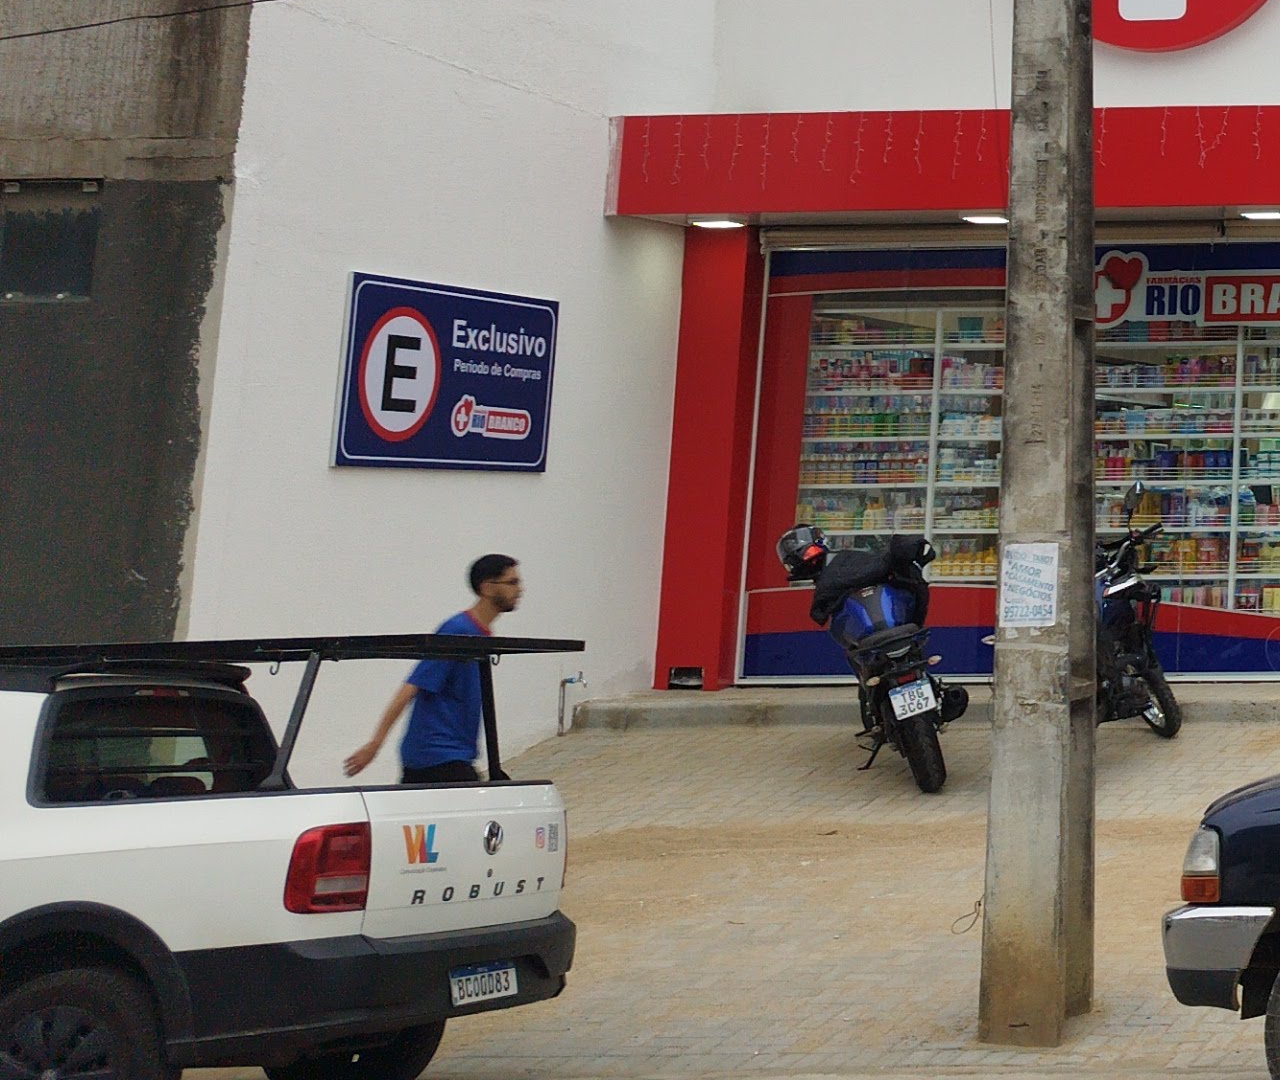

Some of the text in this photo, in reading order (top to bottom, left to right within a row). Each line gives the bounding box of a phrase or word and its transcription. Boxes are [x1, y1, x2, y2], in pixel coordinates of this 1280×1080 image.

[1144, 283, 1202, 316] RIO
[452, 318, 547, 358] Exclusivo
[381, 333, 422, 414] E
[490, 362, 503, 377] de
[503, 363, 543, 382] Compras
[487, 414, 526, 432] BRANCO
[410, 876, 545, 906] ROBUST
